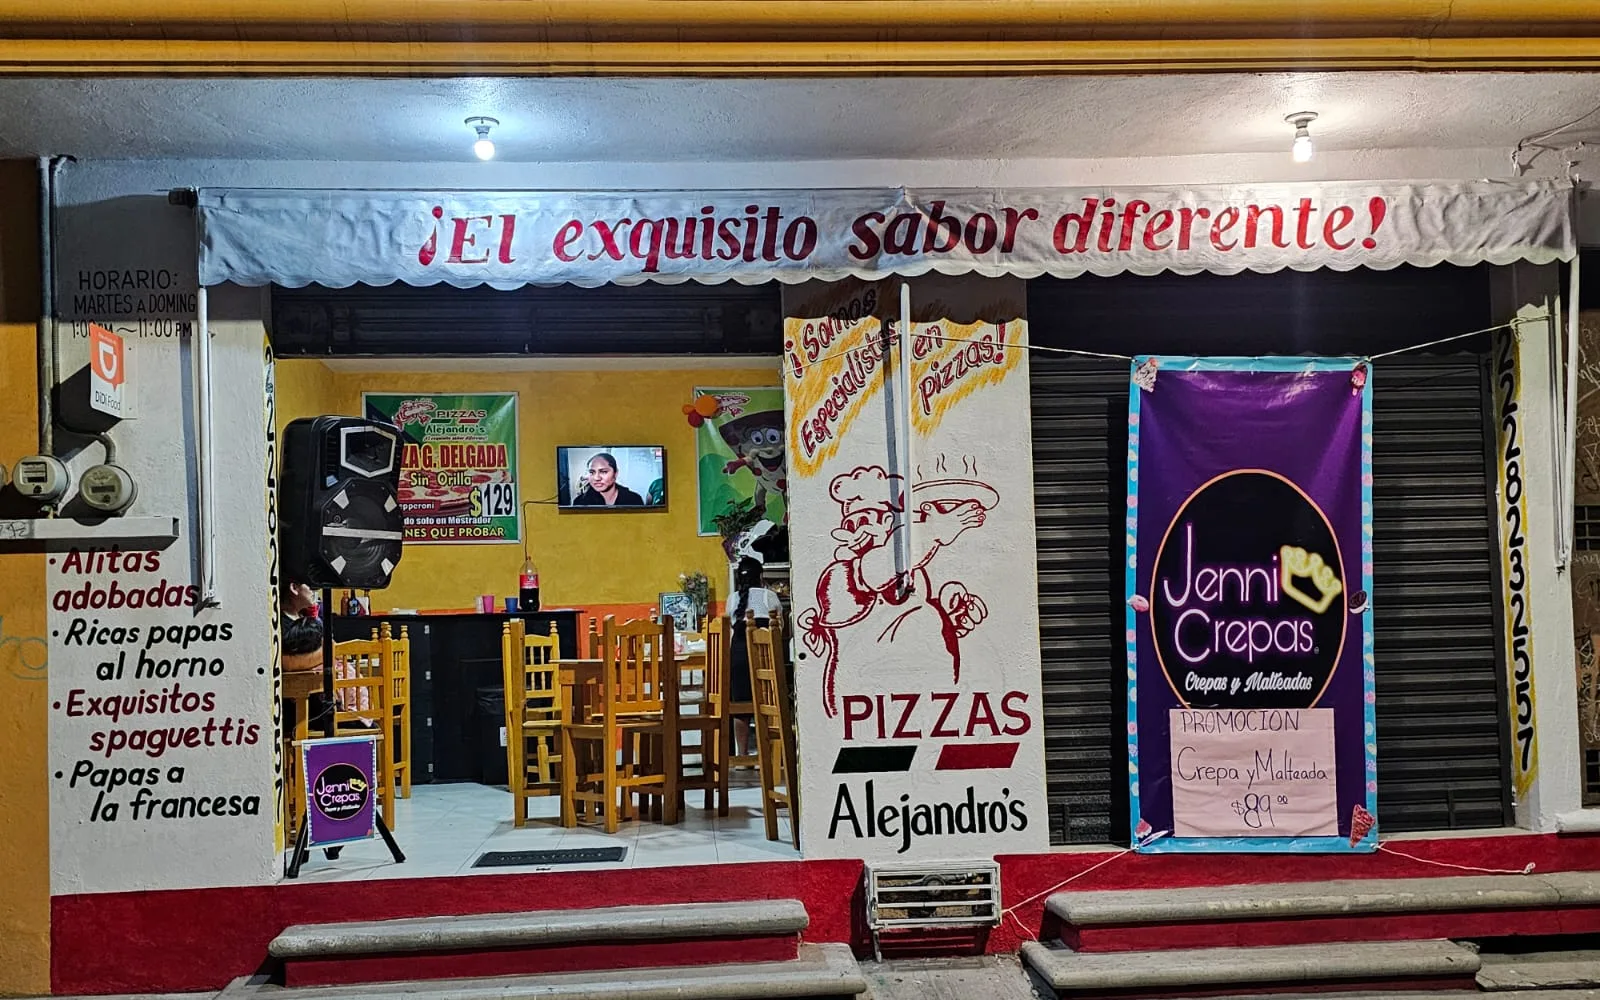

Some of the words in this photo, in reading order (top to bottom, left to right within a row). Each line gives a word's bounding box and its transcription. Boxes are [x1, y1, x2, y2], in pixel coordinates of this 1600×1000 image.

[418, 205, 517, 266] ¡El
[552, 203, 818, 273] exquisito
[848, 200, 1039, 260] sabor
[1052, 196, 1388, 254] diferente!
[78, 269, 180, 291] HORARIO:
[74, 293, 133, 315] MARTES
[149, 293, 197, 314] DOMING
[138, 318, 173, 338] 11:00
[175, 321, 193, 337] PM
[912, 324, 943, 361] en
[918, 319, 1006, 416] pizzas!
[800, 317, 899, 459] Especialistas
[425, 424, 486, 435] Alejandro's
[437, 410, 487, 419] PIZZAS
[440, 444, 508, 468] DELGADA
[410, 472, 430, 486] Sin
[437, 472, 472, 486] Orilla
[470, 483, 513, 517] $129
[405, 528, 428, 537] NES
[430, 527, 455, 539] QUE
[458, 527, 505, 537] PROBAR
[416, 516, 433, 525] solo
[448, 516, 492, 525] Mostrador
[61, 544, 160, 575] Alitas
[1164, 523, 1278, 607] Jenni
[52, 579, 201, 612] adobadas
[64, 618, 139, 647] Ricas
[146, 621, 233, 650] papas
[1174, 608, 1313, 662] Crepas
[96, 651, 125, 680] al
[135, 649, 225, 680] horno
[1185, 671, 1228, 696] Crepas
[1230, 677, 1242, 696] y
[1243, 671, 1313, 693] Malteadas
[67, 683, 216, 722] Exquisitos
[842, 690, 1032, 740] PIZZAS
[1180, 709, 1301, 734] PROMOCION
[89, 717, 260, 758] spaguettis
[70, 760, 160, 791] Papas
[166, 766, 185, 784] a
[1177, 746, 1240, 787] Crepa
[1246, 769, 1256, 790] y
[1254, 748, 1328, 781] Malteada
[316, 776, 350, 795] Jenni
[320, 793, 361, 806] Crepas
[90, 790, 119, 822] la
[131, 788, 261, 820] francesa
[828, 779, 1028, 854] Alejandro's
[1231, 793, 1275, 829] $89
